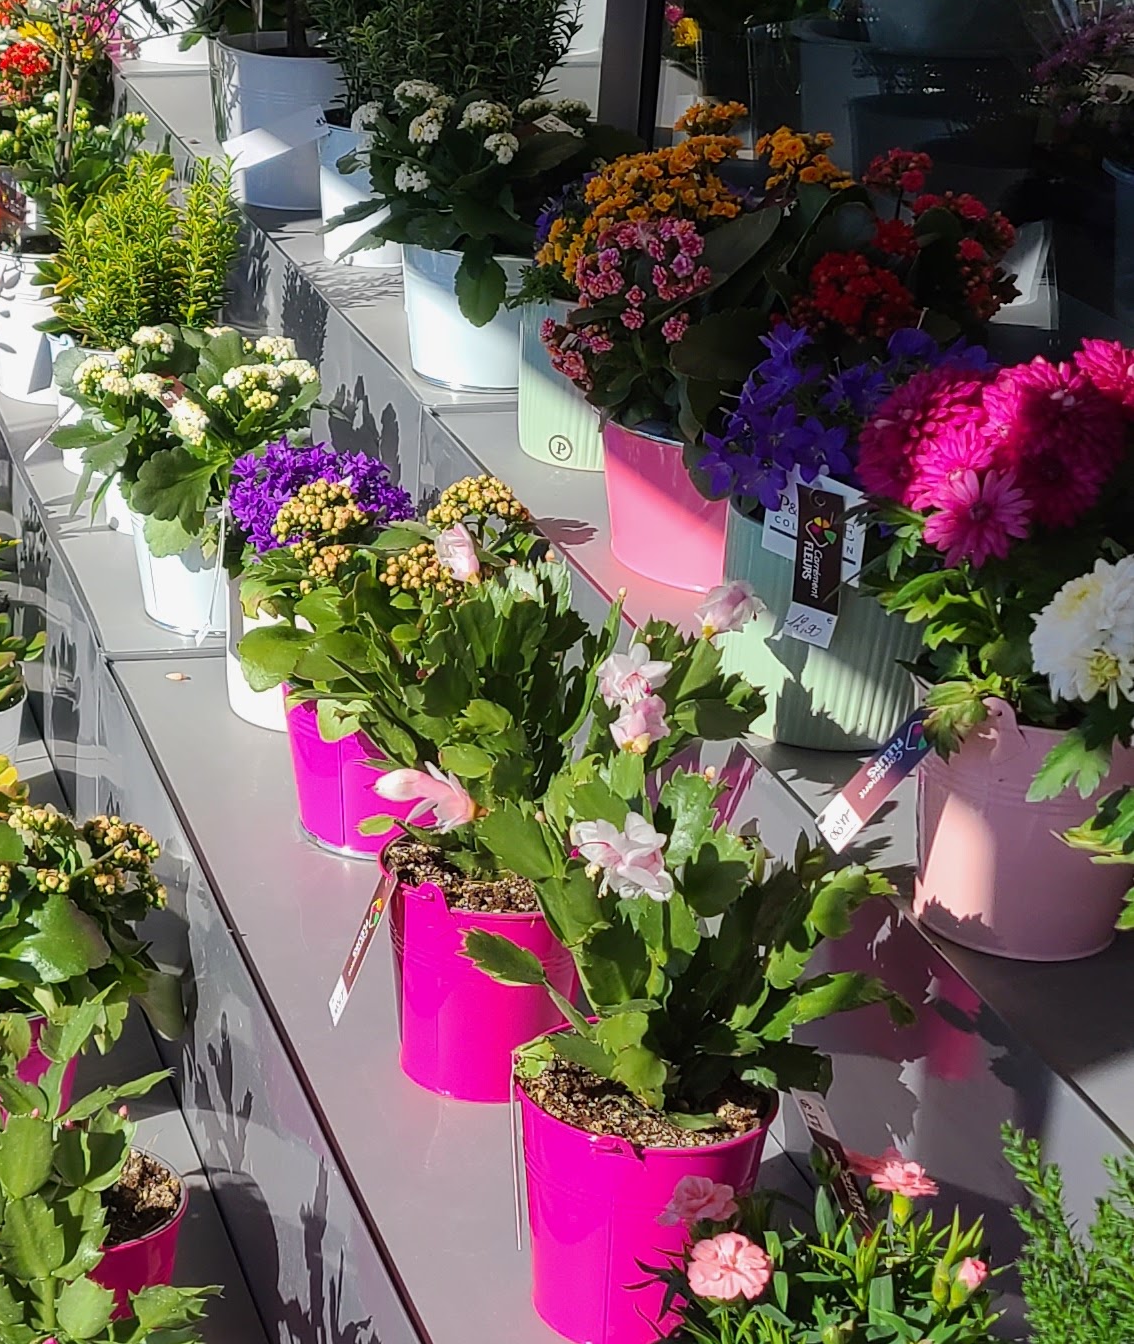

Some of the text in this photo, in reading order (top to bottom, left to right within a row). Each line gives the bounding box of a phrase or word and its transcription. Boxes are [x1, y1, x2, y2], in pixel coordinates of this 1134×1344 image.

[556, 441, 566, 455] P
[802, 540, 814, 581] FLEURS
[866, 737, 904, 777] FLEURS
